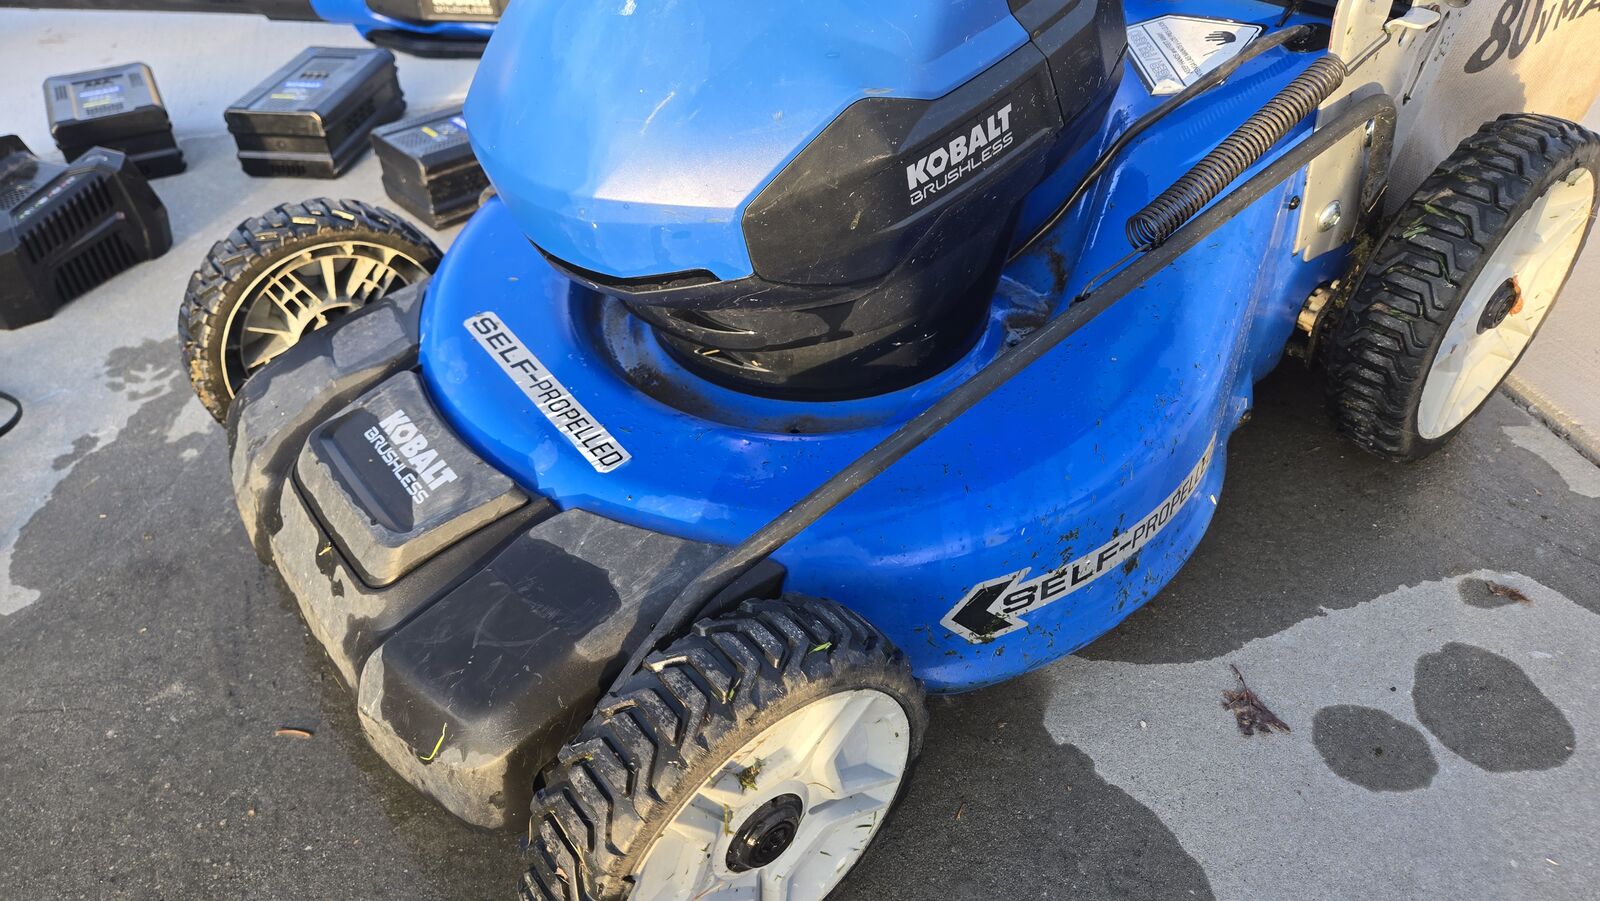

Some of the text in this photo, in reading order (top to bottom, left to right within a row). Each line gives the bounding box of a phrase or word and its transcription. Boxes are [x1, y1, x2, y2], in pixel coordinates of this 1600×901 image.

[906, 102, 1012, 190] KOBALT
[909, 131, 1014, 205] BRUSHLESS
[473, 317, 623, 467] SELF-PROPELLED
[364, 426, 430, 504] BRUSHLESS
[379, 409, 458, 491] KOBALT
